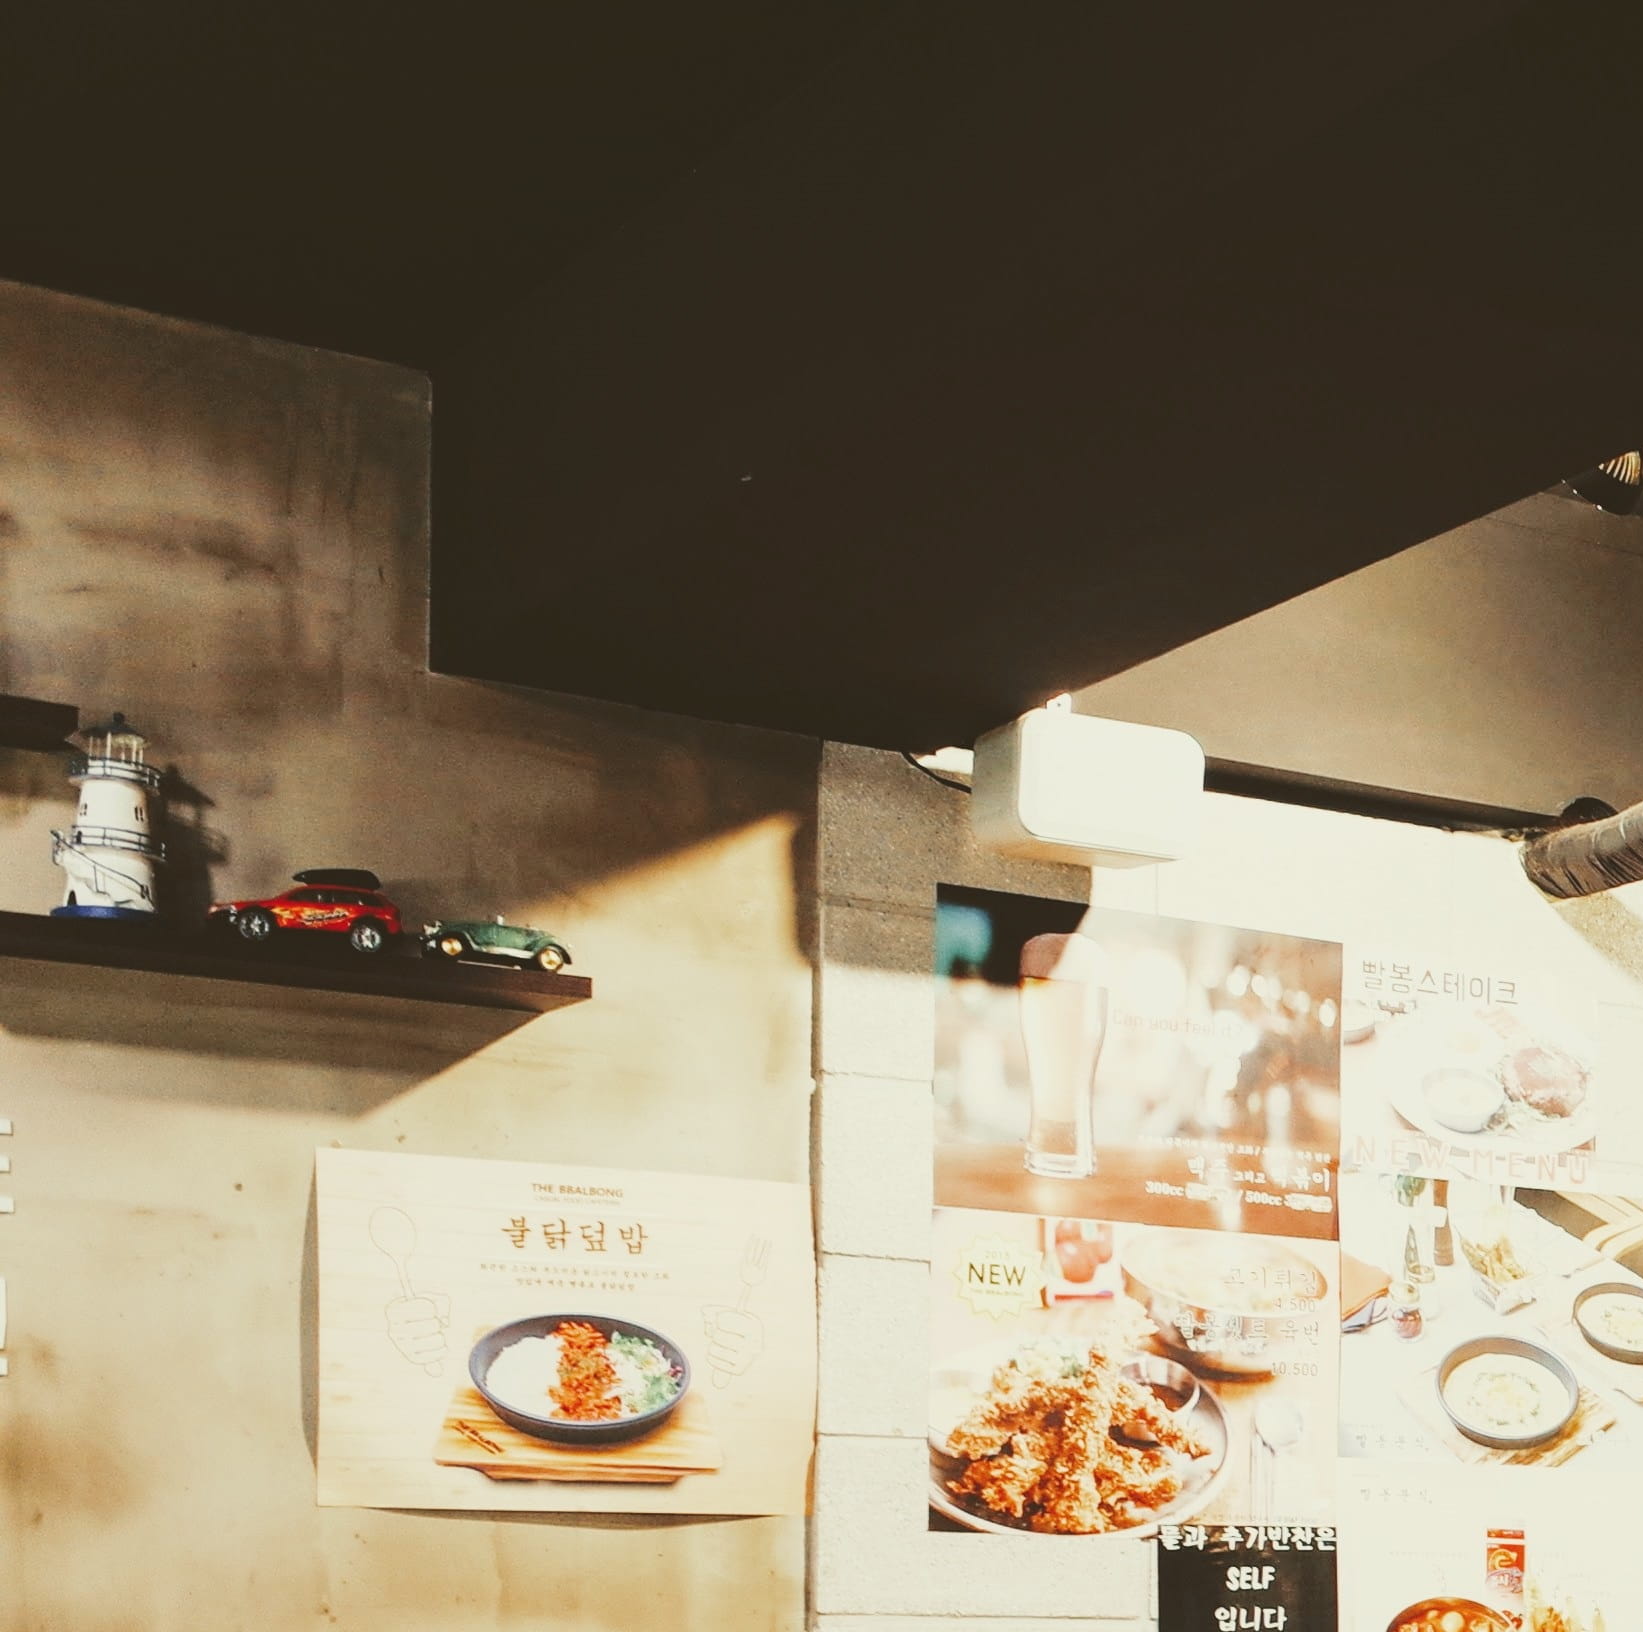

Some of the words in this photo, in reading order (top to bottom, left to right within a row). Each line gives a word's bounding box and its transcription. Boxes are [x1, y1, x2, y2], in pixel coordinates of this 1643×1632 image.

[1363, 960, 1518, 1005] 빨봉스테이크
[1355, 1135, 1449, 1169] NEW
[1472, 1149, 1589, 1184] MENU
[532, 1183, 554, 1193] THE
[559, 1185, 624, 1198] BBALBONG
[1145, 1181, 1185, 1197] 300cc
[1245, 1191, 1283, 1207] 500cc
[500, 1216, 649, 1254] 불닭덮밥
[968, 1262, 1026, 1286] NEW
[1220, 1525, 1337, 1550] 추가반찬은
[1226, 1566, 1276, 1591] SELF
[1214, 1606, 1287, 1632] 입니다
